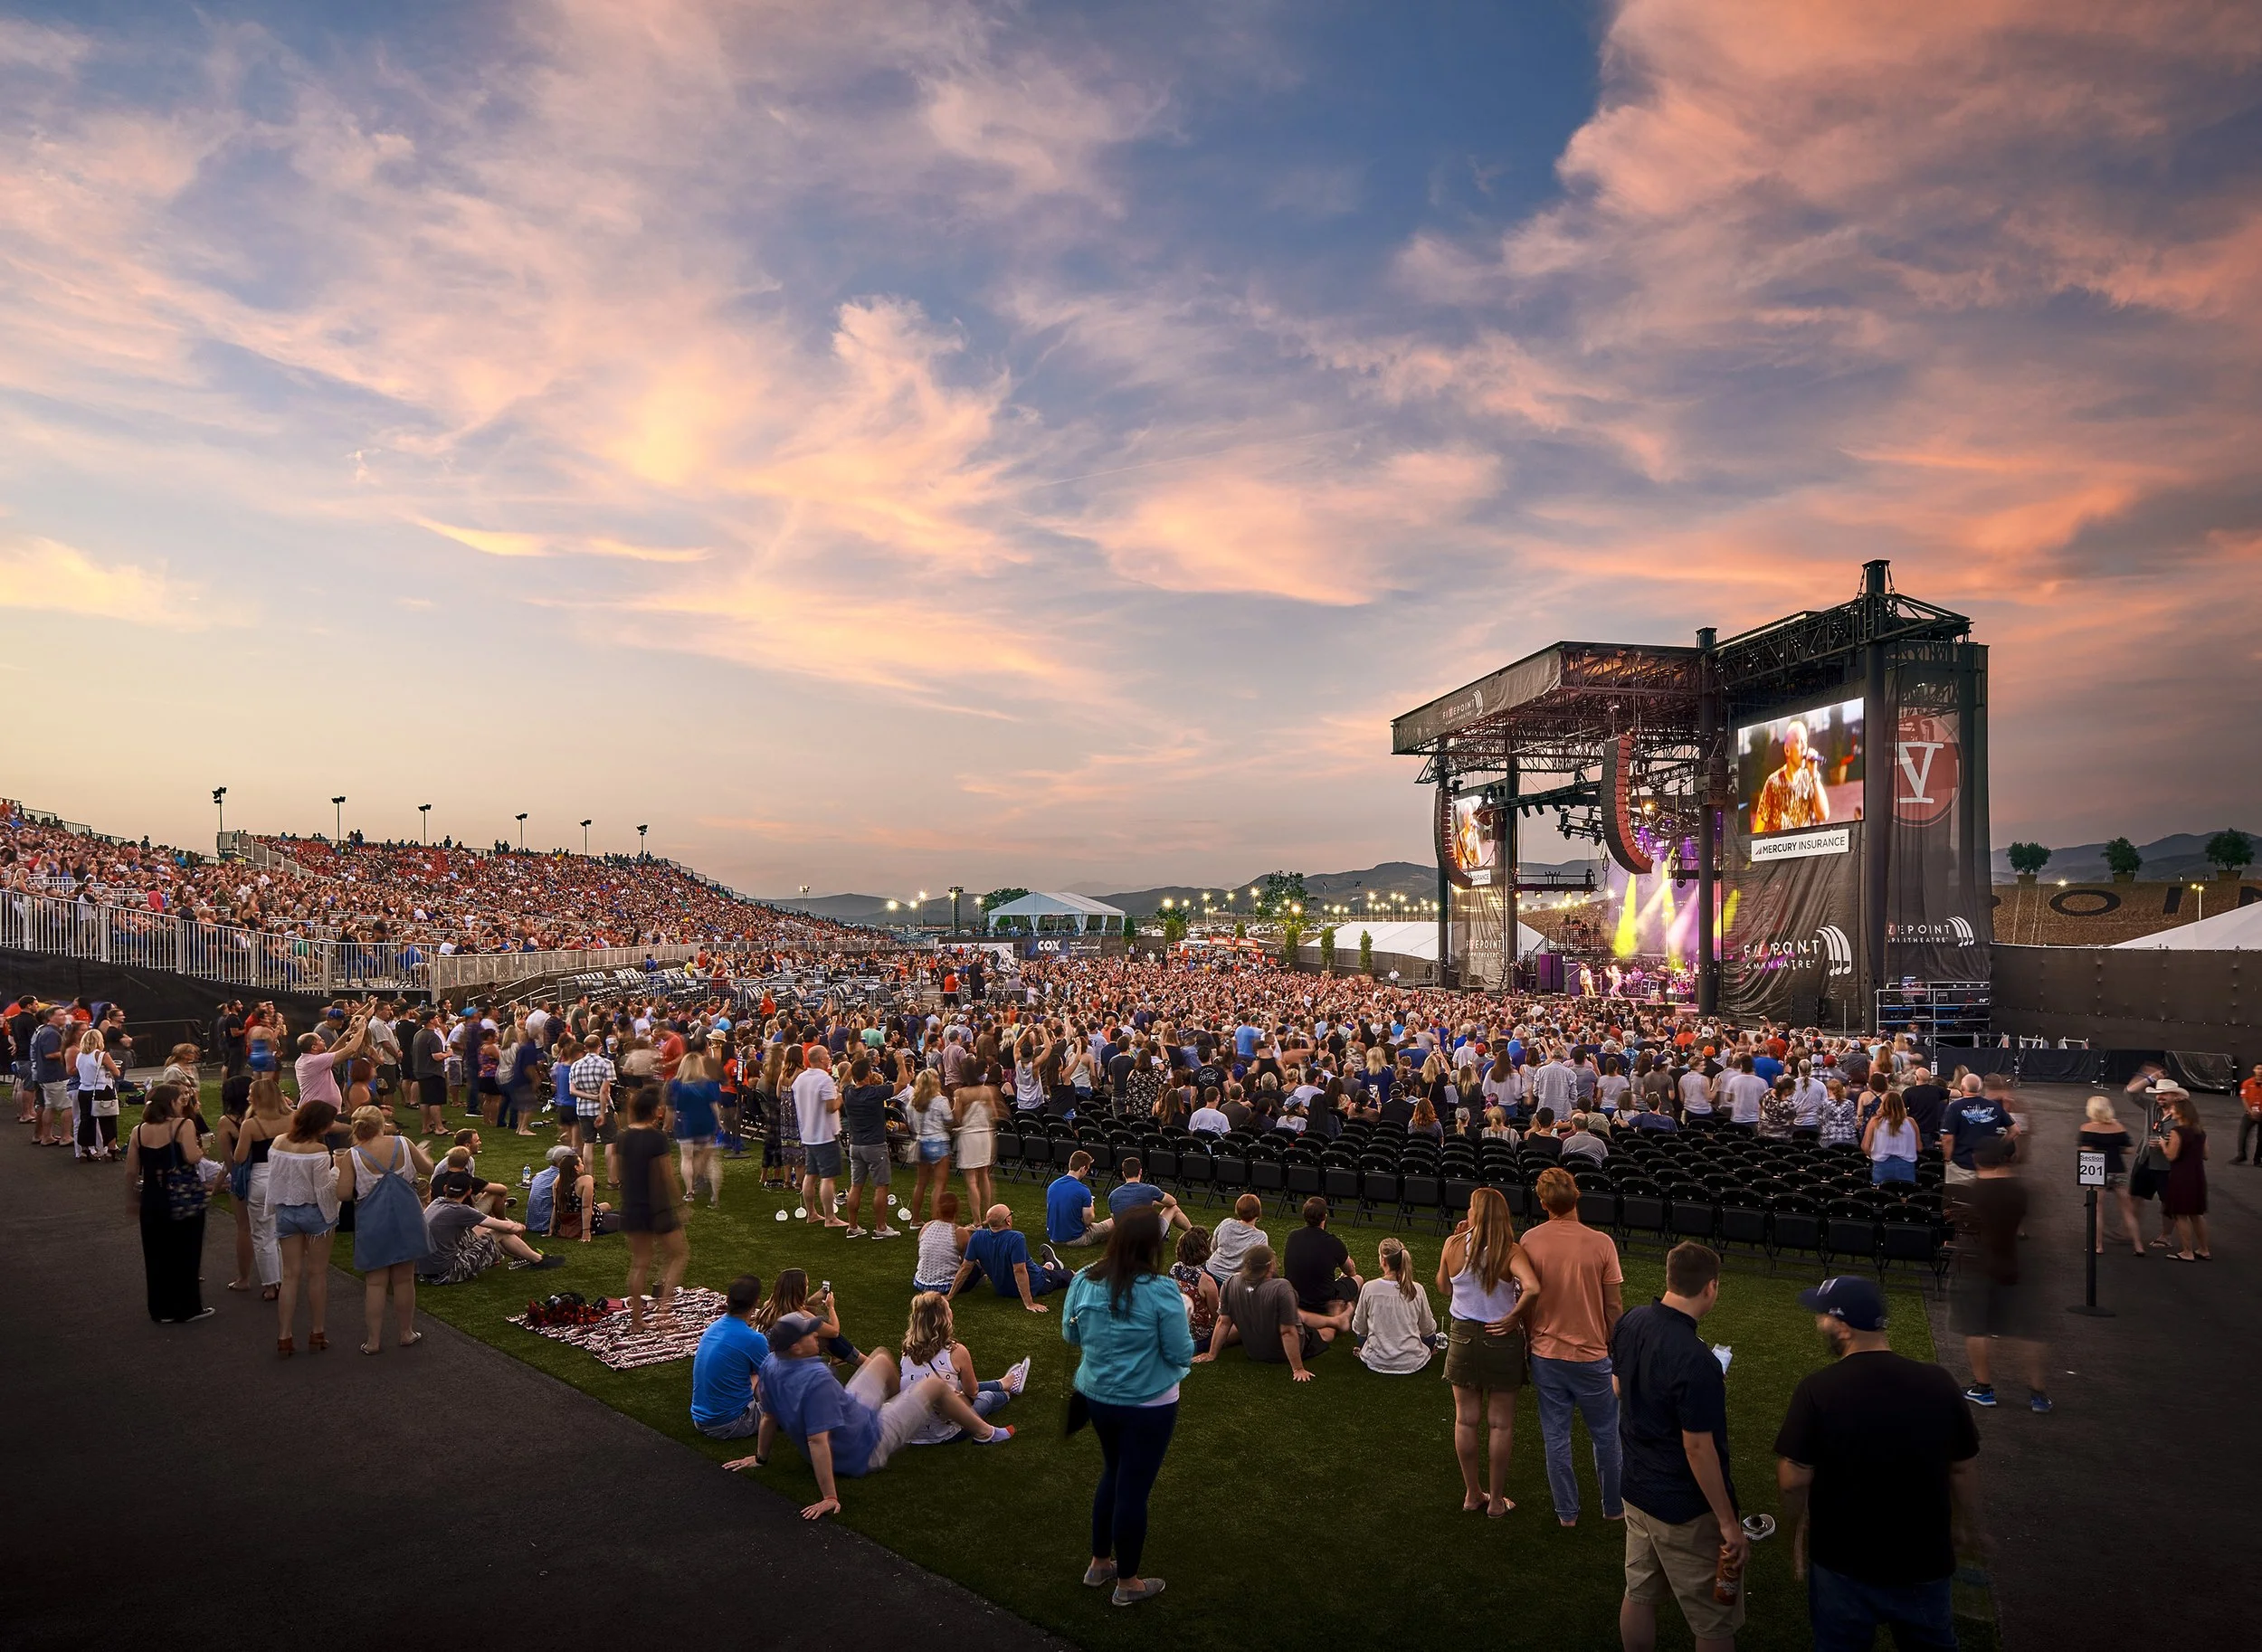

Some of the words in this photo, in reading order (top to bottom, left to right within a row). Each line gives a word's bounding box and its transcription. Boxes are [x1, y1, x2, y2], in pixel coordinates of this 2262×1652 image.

[1763, 841, 1797, 854] MERCURY
[1798, 836, 1845, 850] INSURANCE
[1037, 940, 1061, 953] COX
[2080, 1164, 2103, 1176] 201
